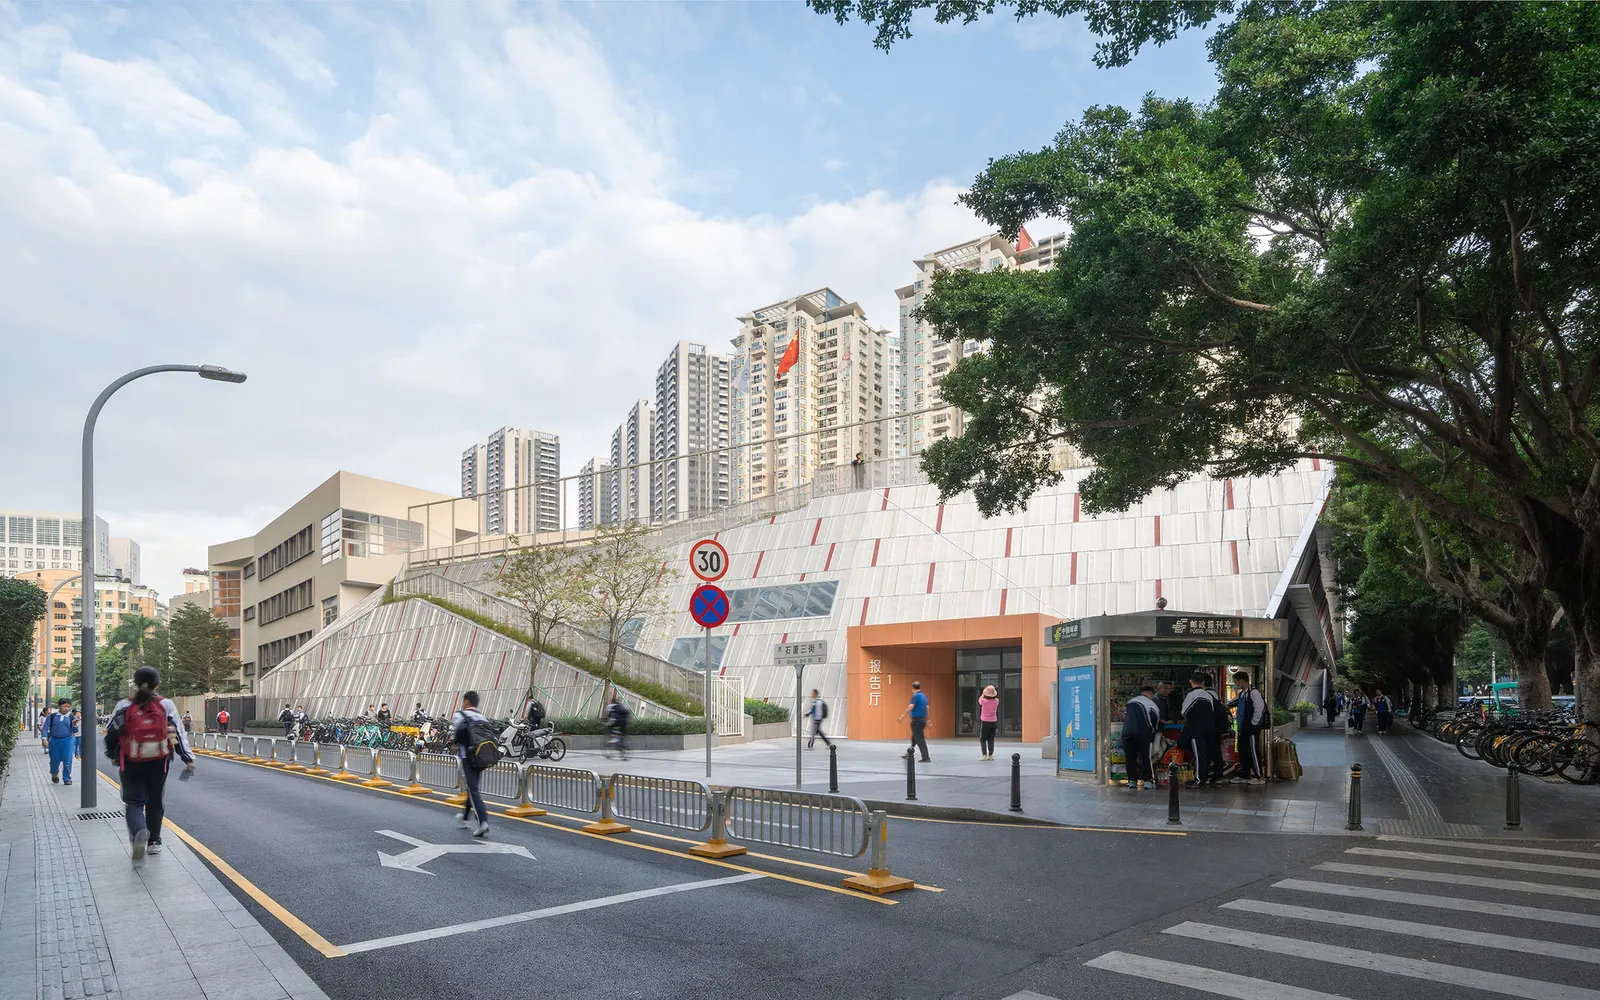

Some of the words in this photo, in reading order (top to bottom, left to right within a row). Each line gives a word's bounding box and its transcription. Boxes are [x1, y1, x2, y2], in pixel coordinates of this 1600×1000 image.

[698, 551, 720, 572] 30
[1189, 619, 1232, 629] 邮政报刊亭
[785, 644, 815, 655] 石厦三街
[869, 659, 881, 706] 报告厅
[887, 674, 892, 685] 1
